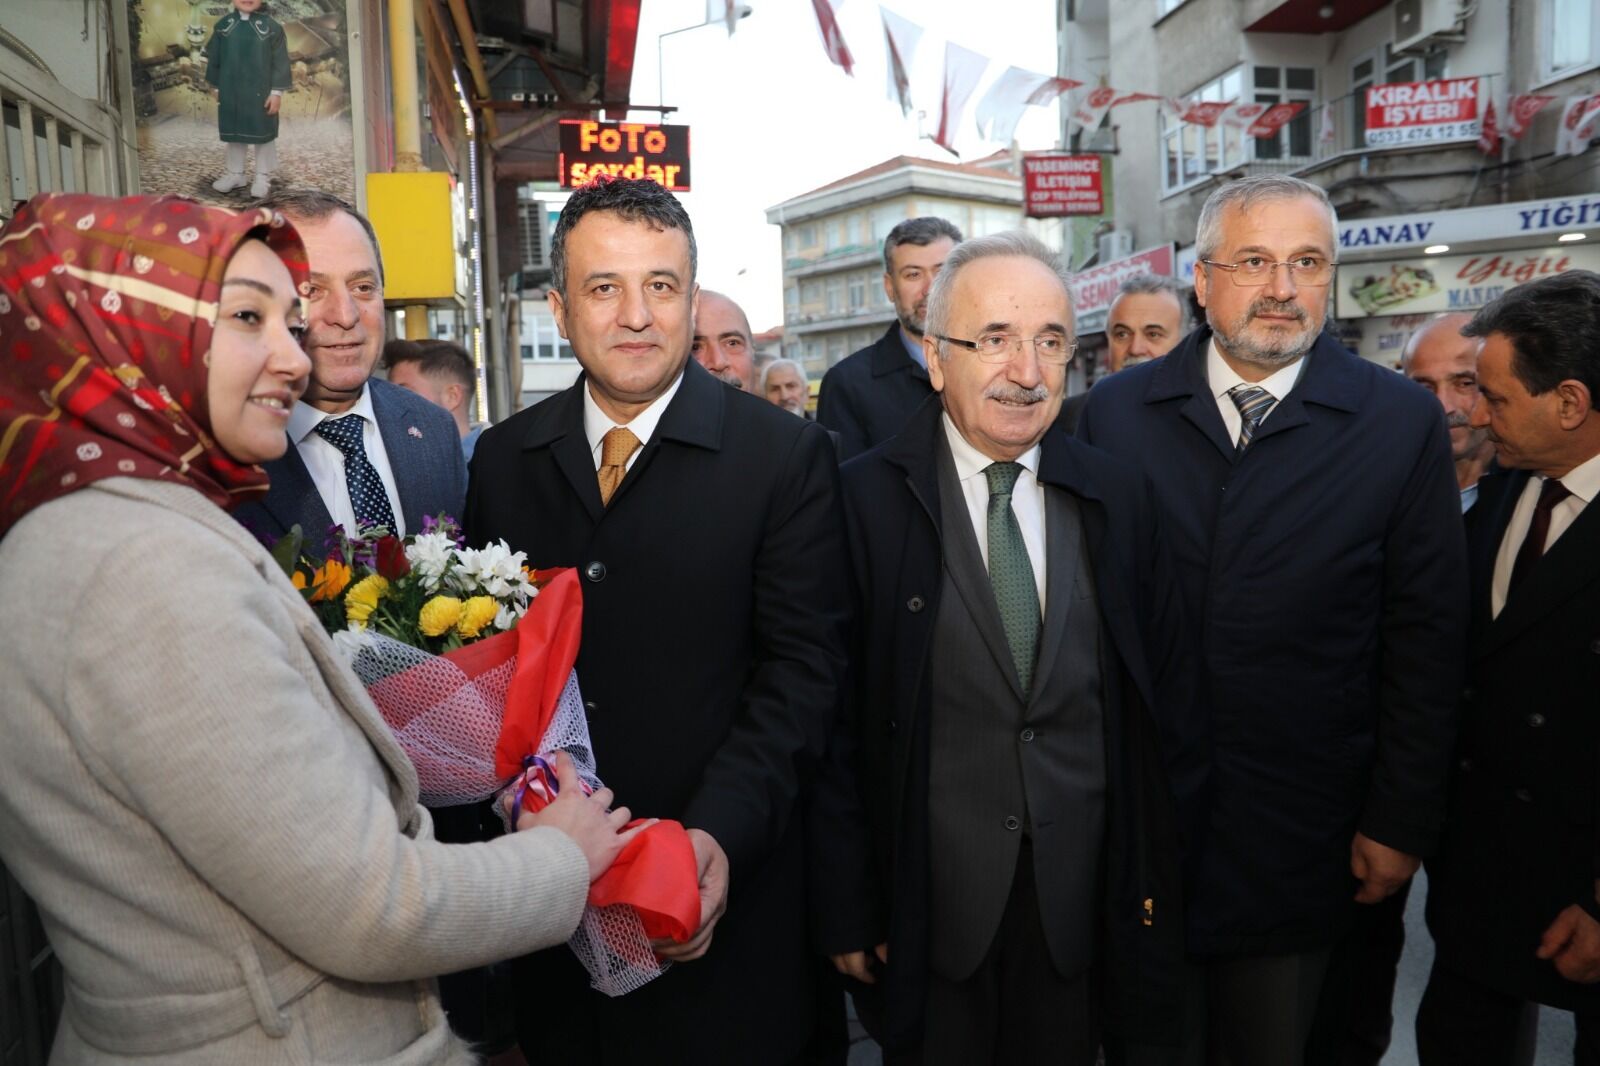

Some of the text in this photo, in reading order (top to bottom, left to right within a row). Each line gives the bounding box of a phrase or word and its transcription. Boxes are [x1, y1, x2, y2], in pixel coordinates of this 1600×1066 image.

[1407, 127, 1433, 139] 474
[1437, 125, 1454, 138] 12
[1459, 122, 1480, 137] 55
[1031, 190, 1050, 201] CEP
